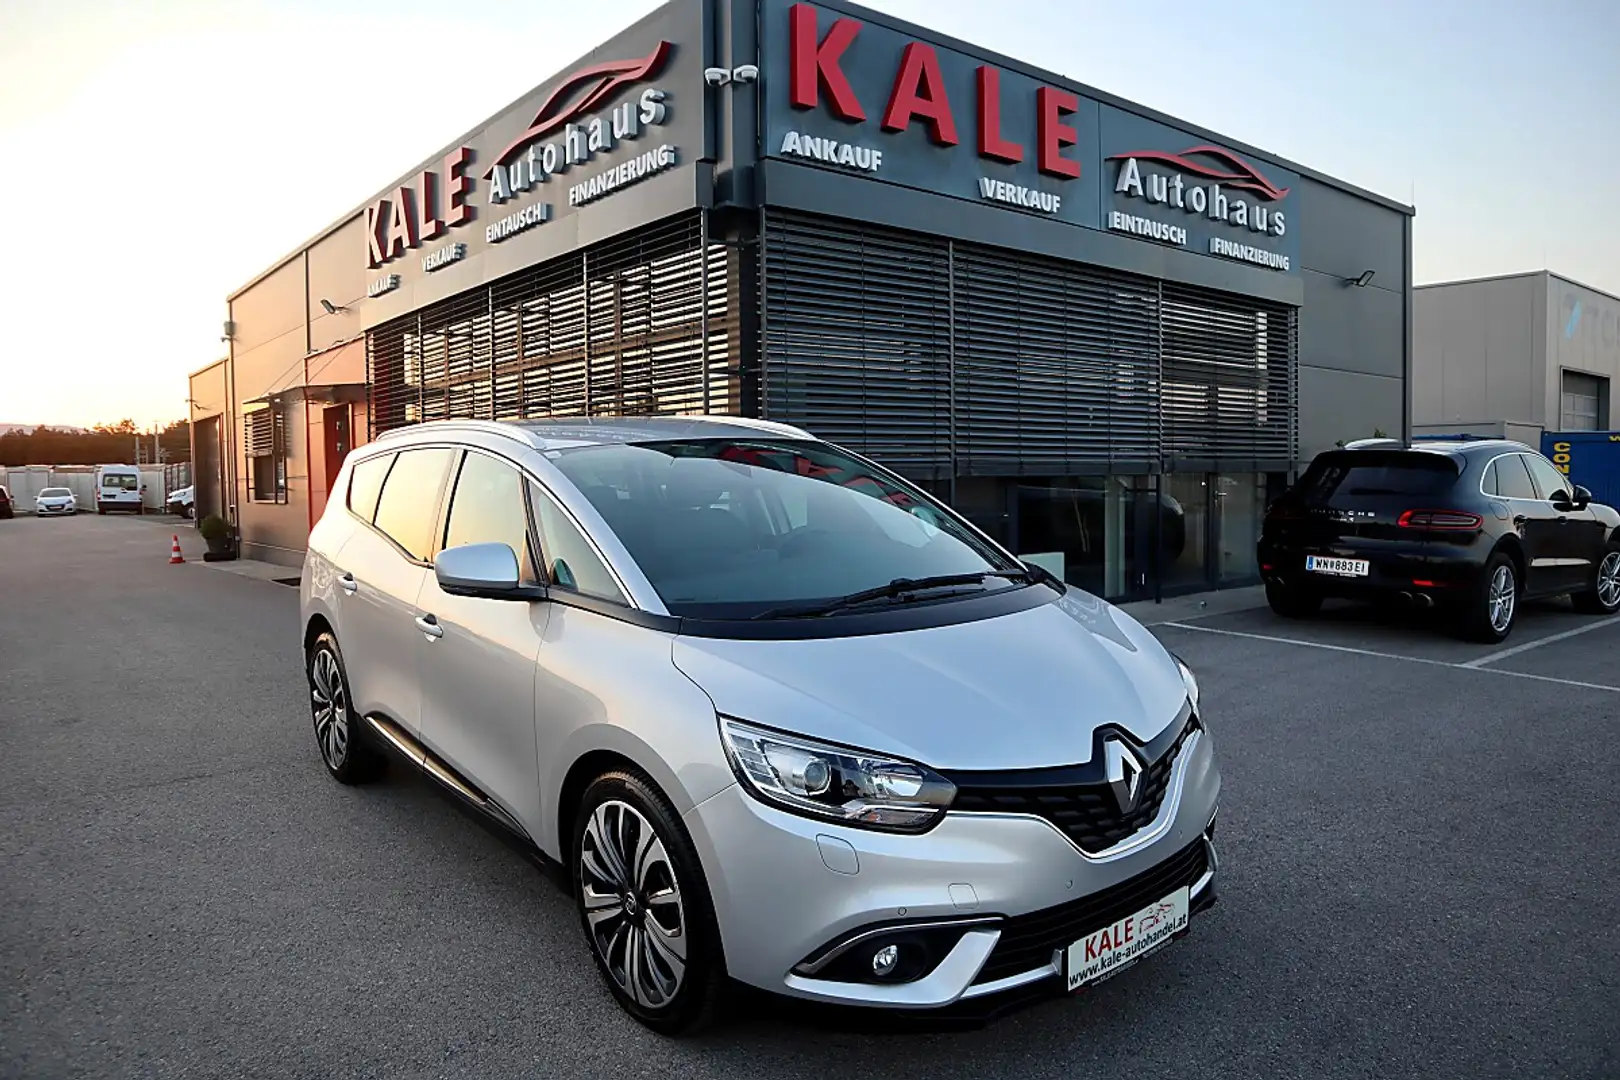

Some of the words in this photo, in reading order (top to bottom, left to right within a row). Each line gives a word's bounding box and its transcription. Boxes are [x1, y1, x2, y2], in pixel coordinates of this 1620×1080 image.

[789, 3, 1080, 180] KALE
[488, 87, 666, 204] Autohaus
[780, 130, 883, 173] ANKAUF
[568, 144, 675, 207] FINANZIERUNG
[976, 177, 1062, 214] VERKAUF
[1115, 157, 1287, 237] Autohaus
[364, 146, 473, 268] KALE
[485, 202, 549, 243] EINTAUSCH
[1108, 210, 1187, 246] EINTAUSCH
[1209, 237, 1290, 271] FINANZIERUNG
[1069, 913, 1187, 987] www.kale-autohandel.at
[1084, 917, 1134, 963] KALE
